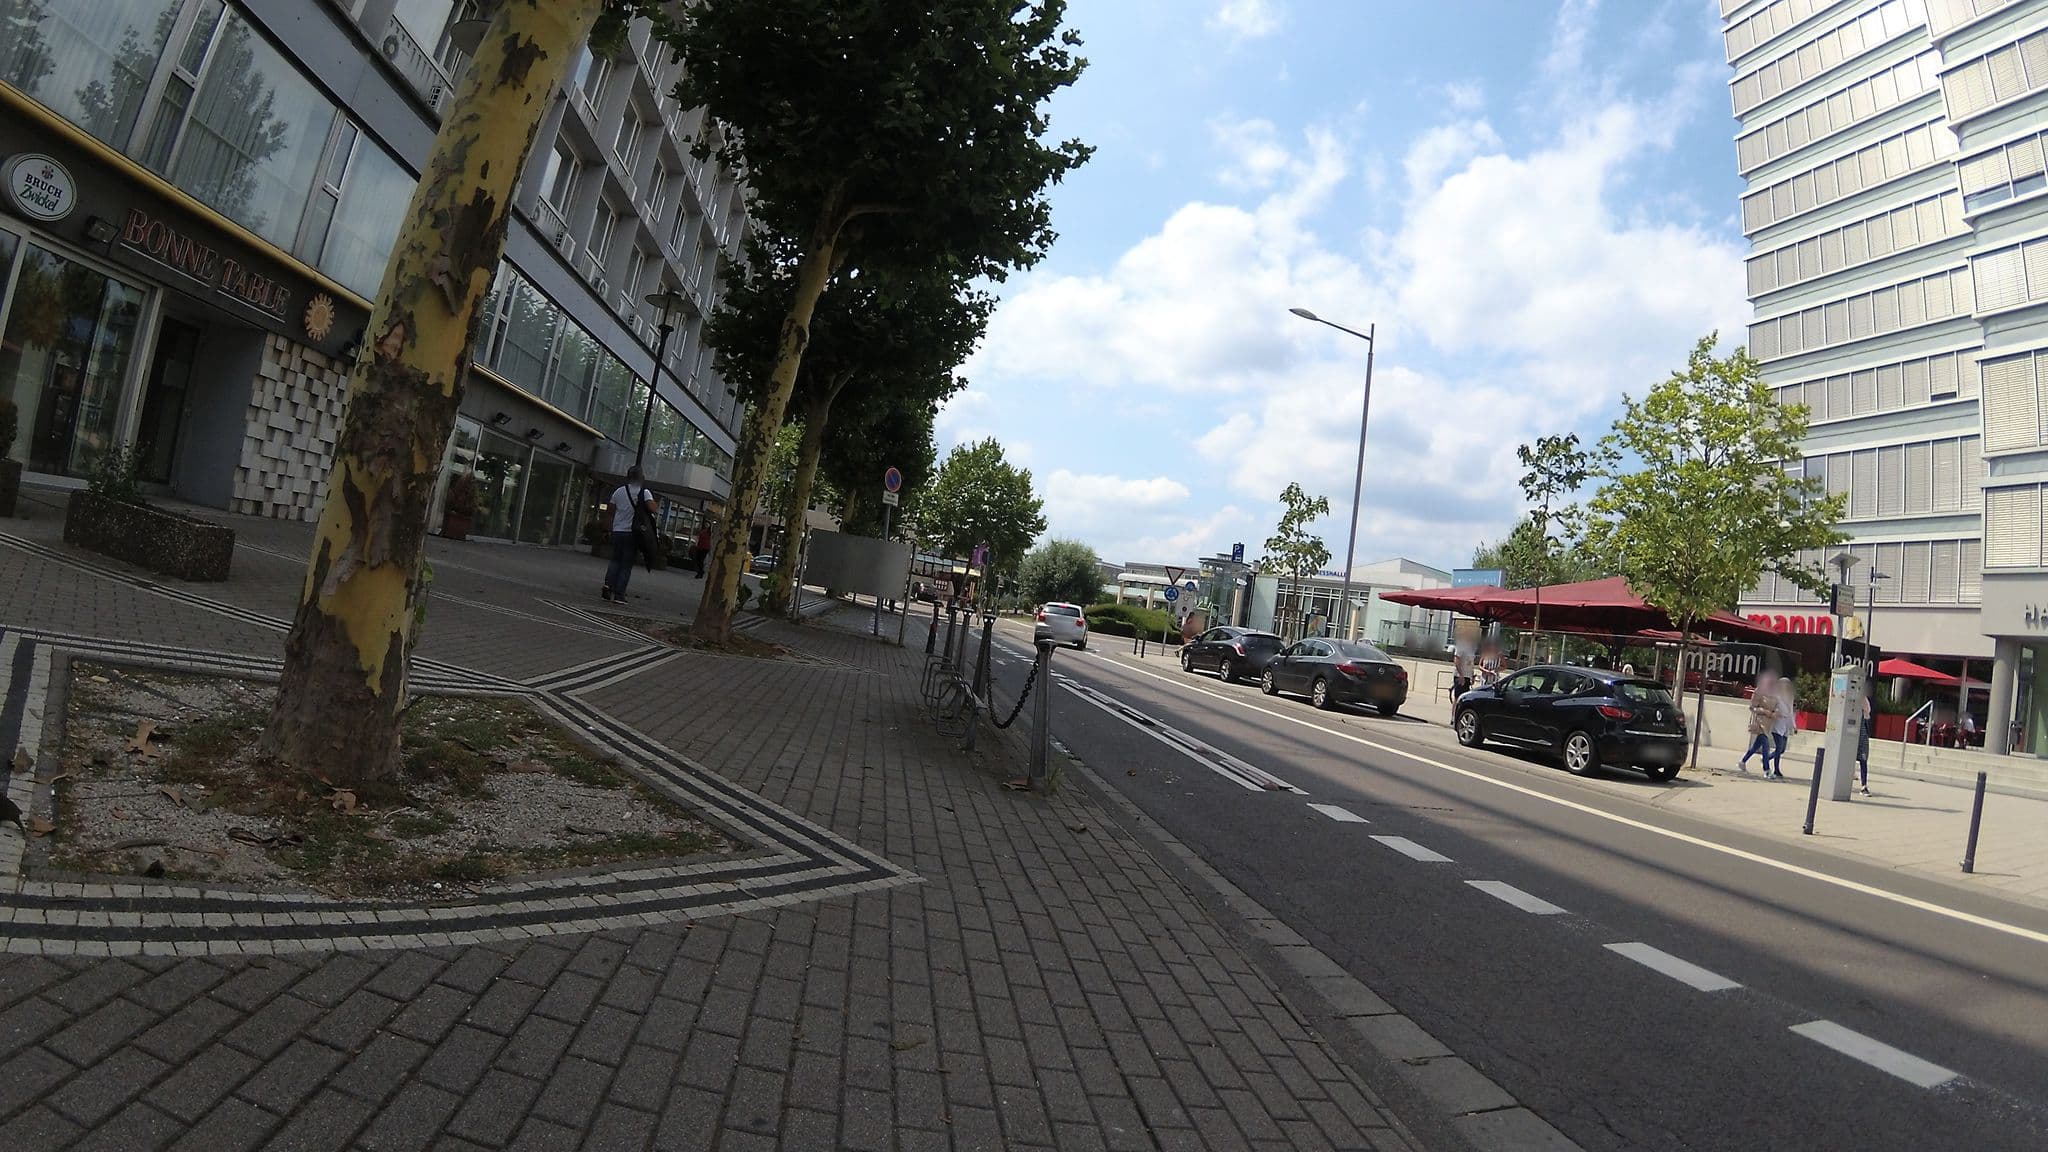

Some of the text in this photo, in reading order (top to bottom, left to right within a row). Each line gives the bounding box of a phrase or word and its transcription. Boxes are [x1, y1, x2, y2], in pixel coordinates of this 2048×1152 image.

[19, 184, 60, 211] Zwickel
[25, 173, 63, 199] BRUCH
[122, 208, 291, 316] BONNE TABLE
